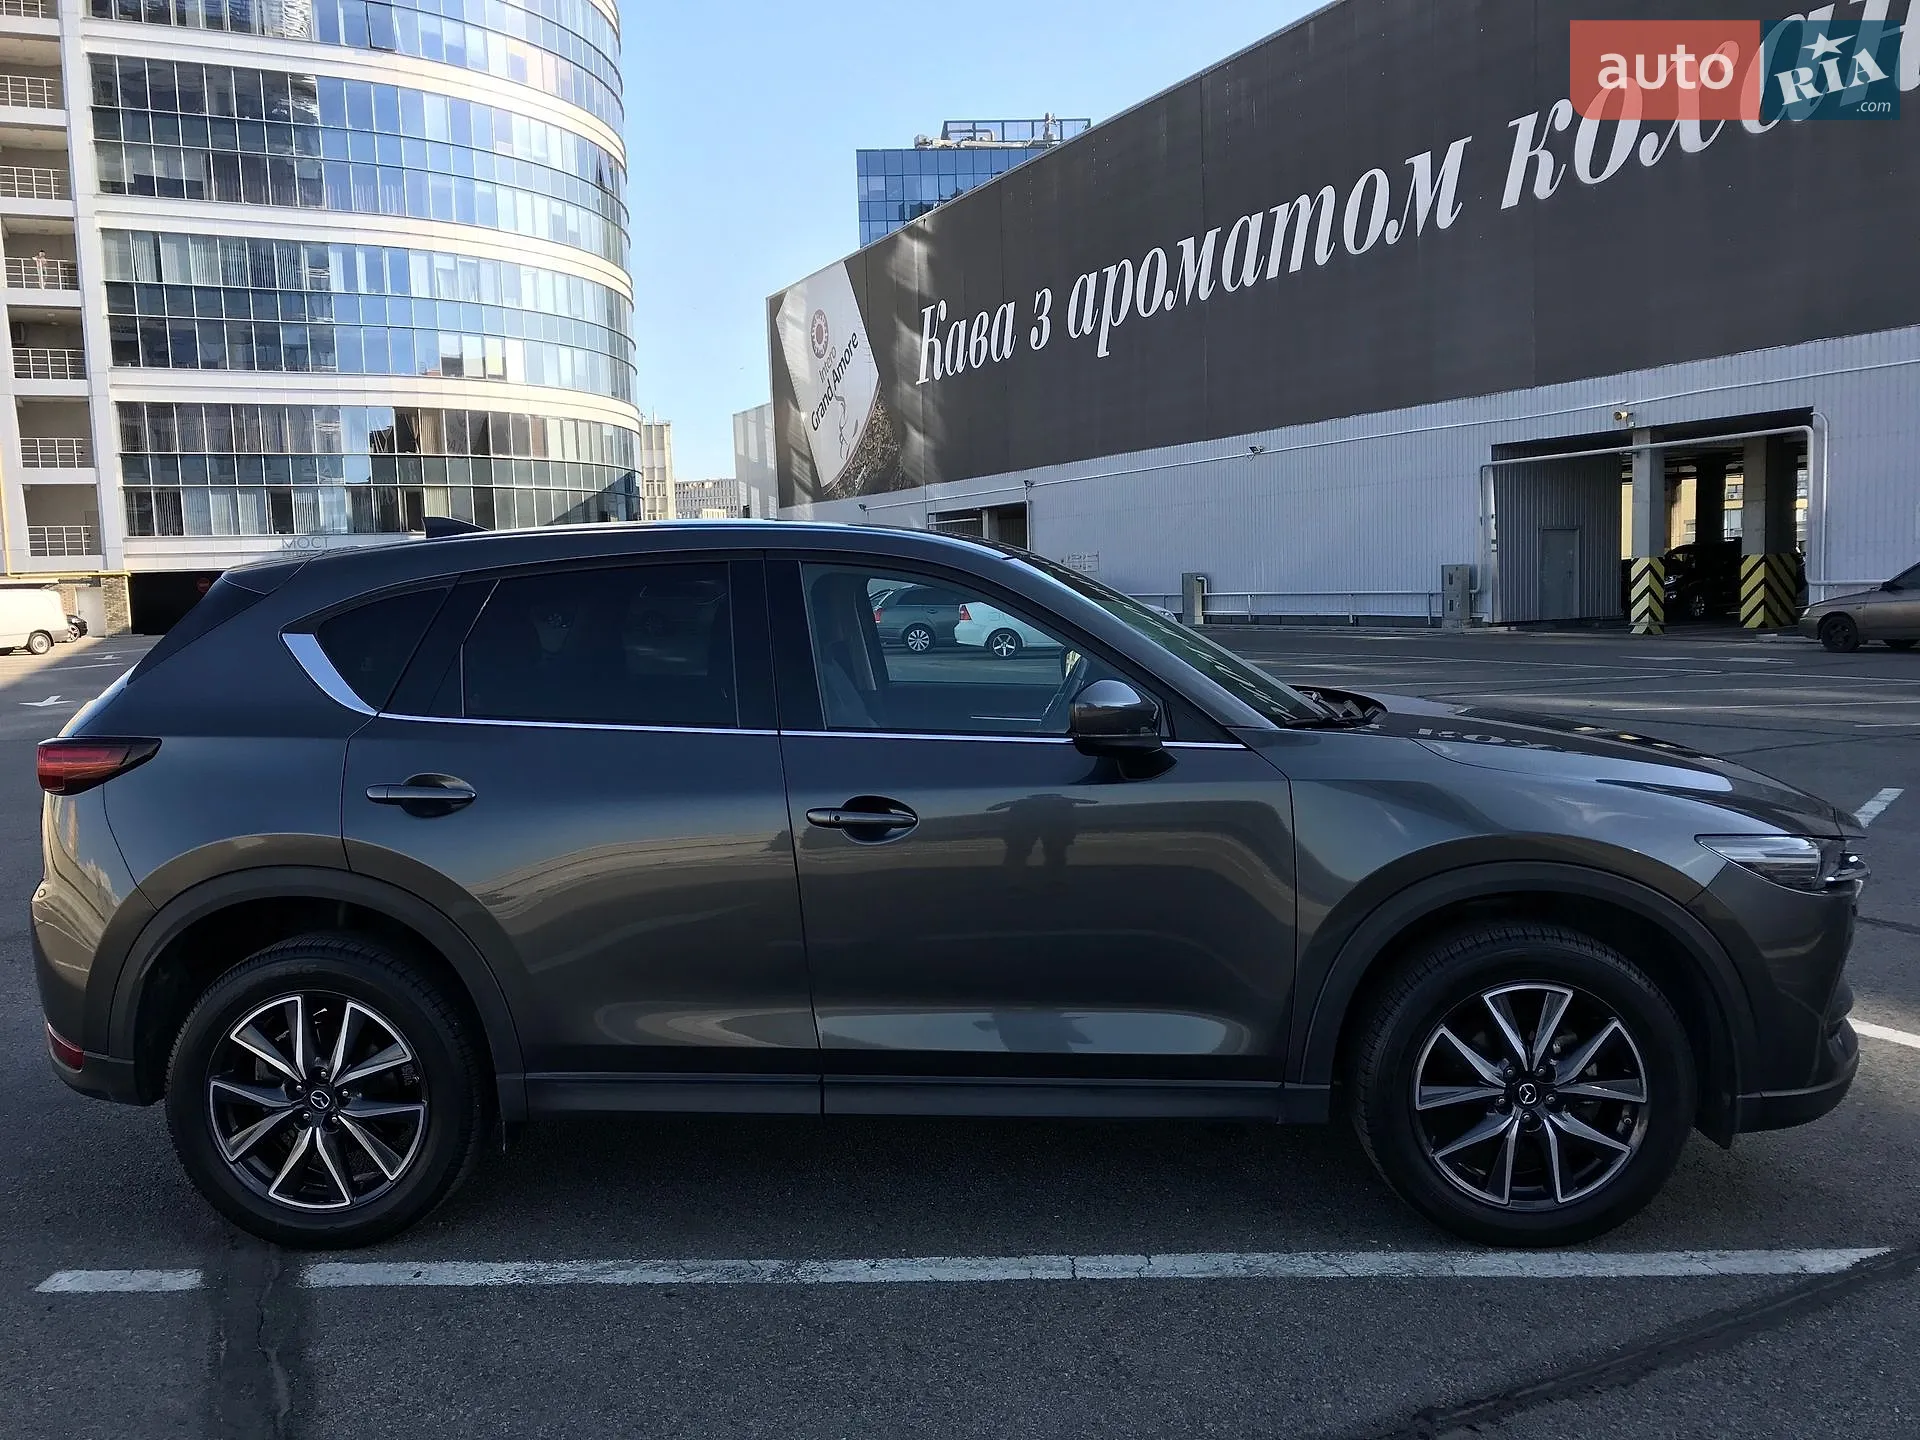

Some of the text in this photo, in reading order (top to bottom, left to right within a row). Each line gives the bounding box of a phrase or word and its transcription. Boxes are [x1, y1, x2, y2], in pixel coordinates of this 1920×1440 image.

[916, 300, 1017, 385] Кава
[1030, 288, 1052, 350] з
[1067, 136, 1472, 358] ароматом
[811, 332, 858, 431] Grand Amore
